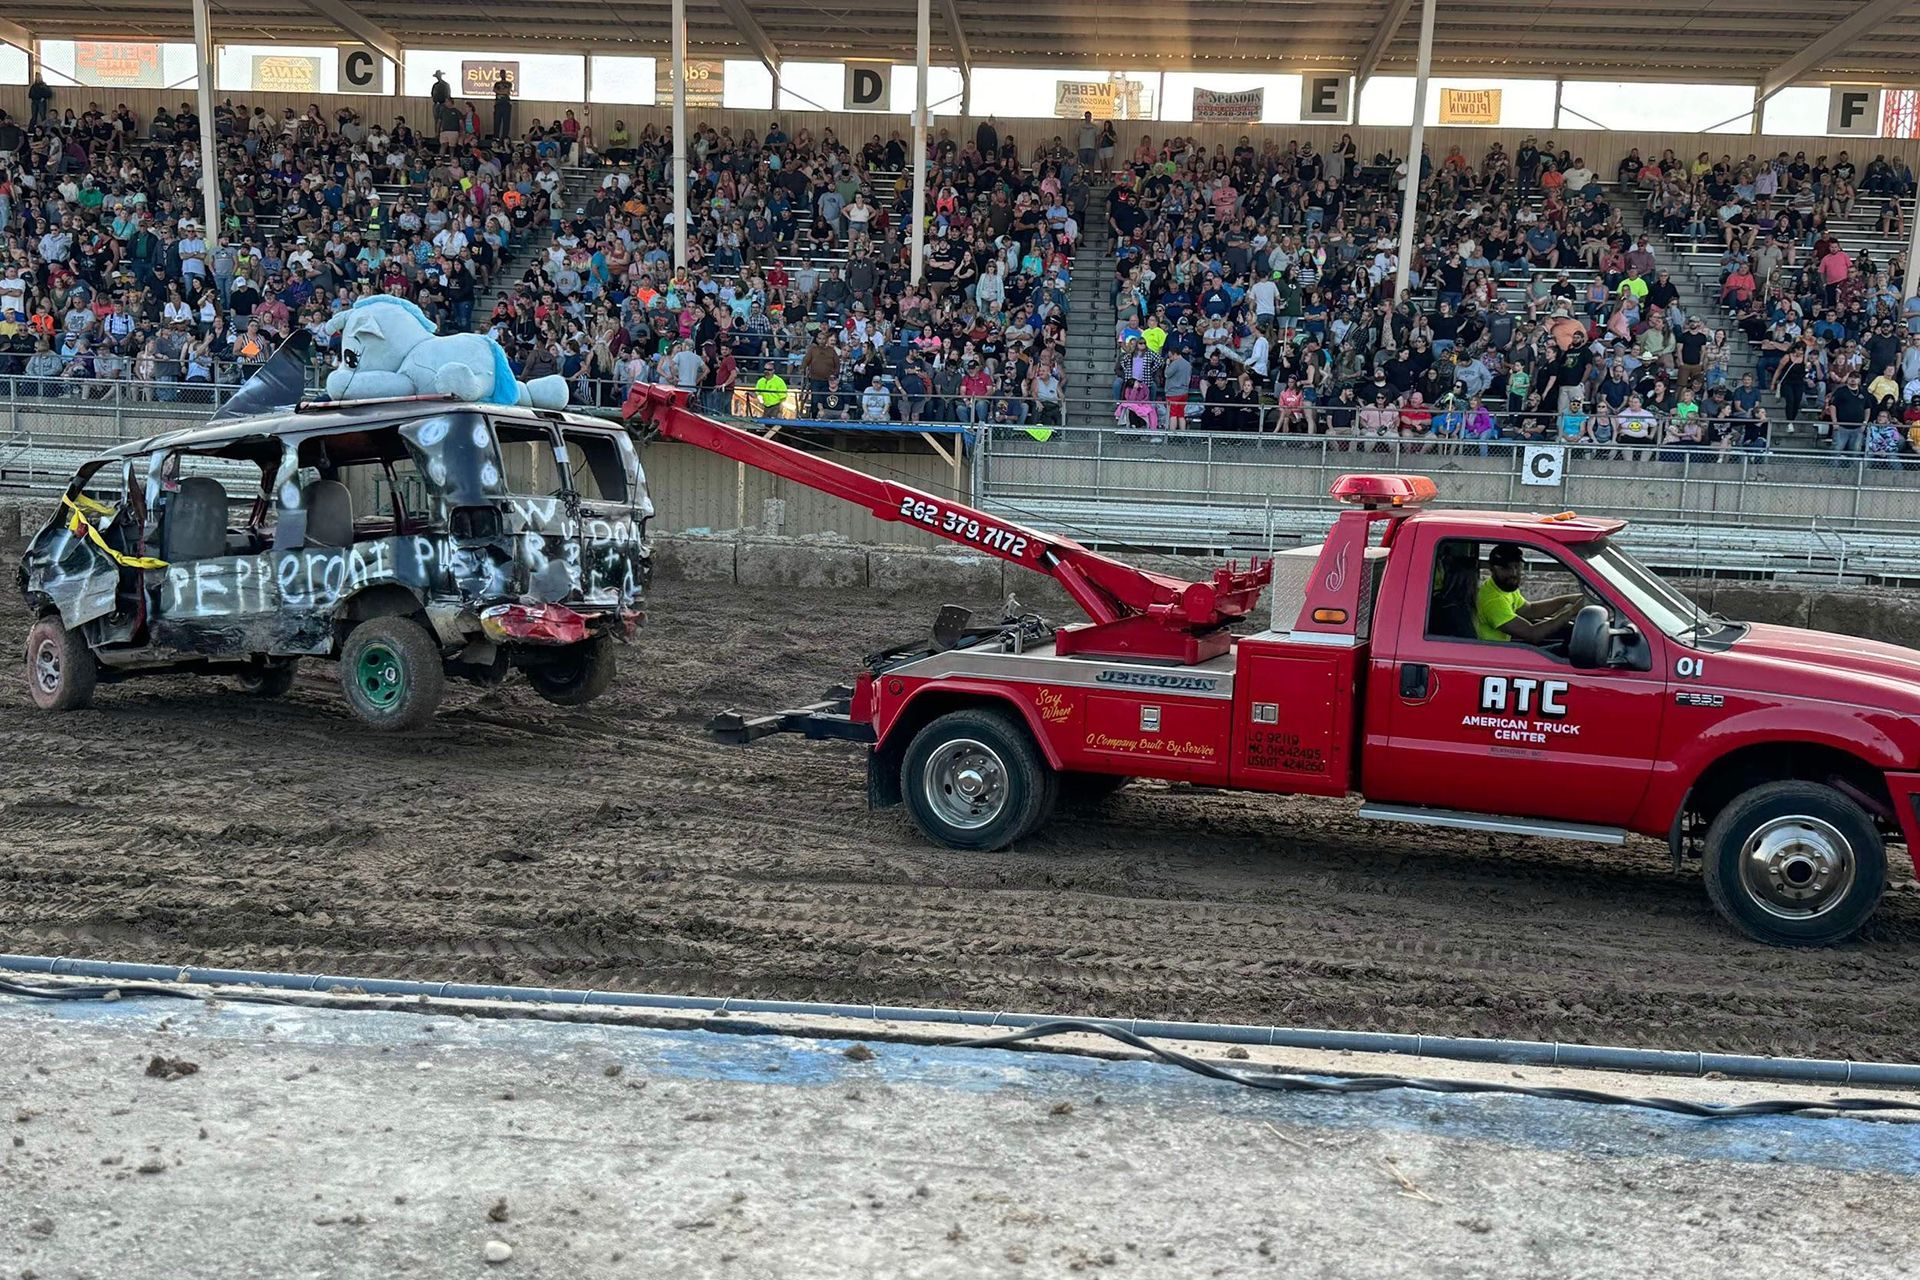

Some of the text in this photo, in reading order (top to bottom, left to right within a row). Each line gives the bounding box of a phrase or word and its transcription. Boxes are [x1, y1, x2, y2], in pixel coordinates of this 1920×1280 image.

[344, 51, 373, 86] C
[853, 69, 884, 104] D
[1209, 92, 1262, 104] Seasons
[1311, 78, 1338, 113] E
[1840, 92, 1869, 128] F
[1530, 453, 1555, 478] C
[1676, 656, 1704, 677] 01
[1480, 676, 1568, 717] ATC
[1462, 715, 1581, 735] AMERICAN TRUCK
[1494, 729, 1546, 744] CENTER
[1096, 734, 1138, 752] Company
[1139, 738, 1164, 750] Built
[1166, 740, 1182, 756] By
[1182, 741, 1215, 756] Service
[1248, 755, 1279, 767] USDOT
